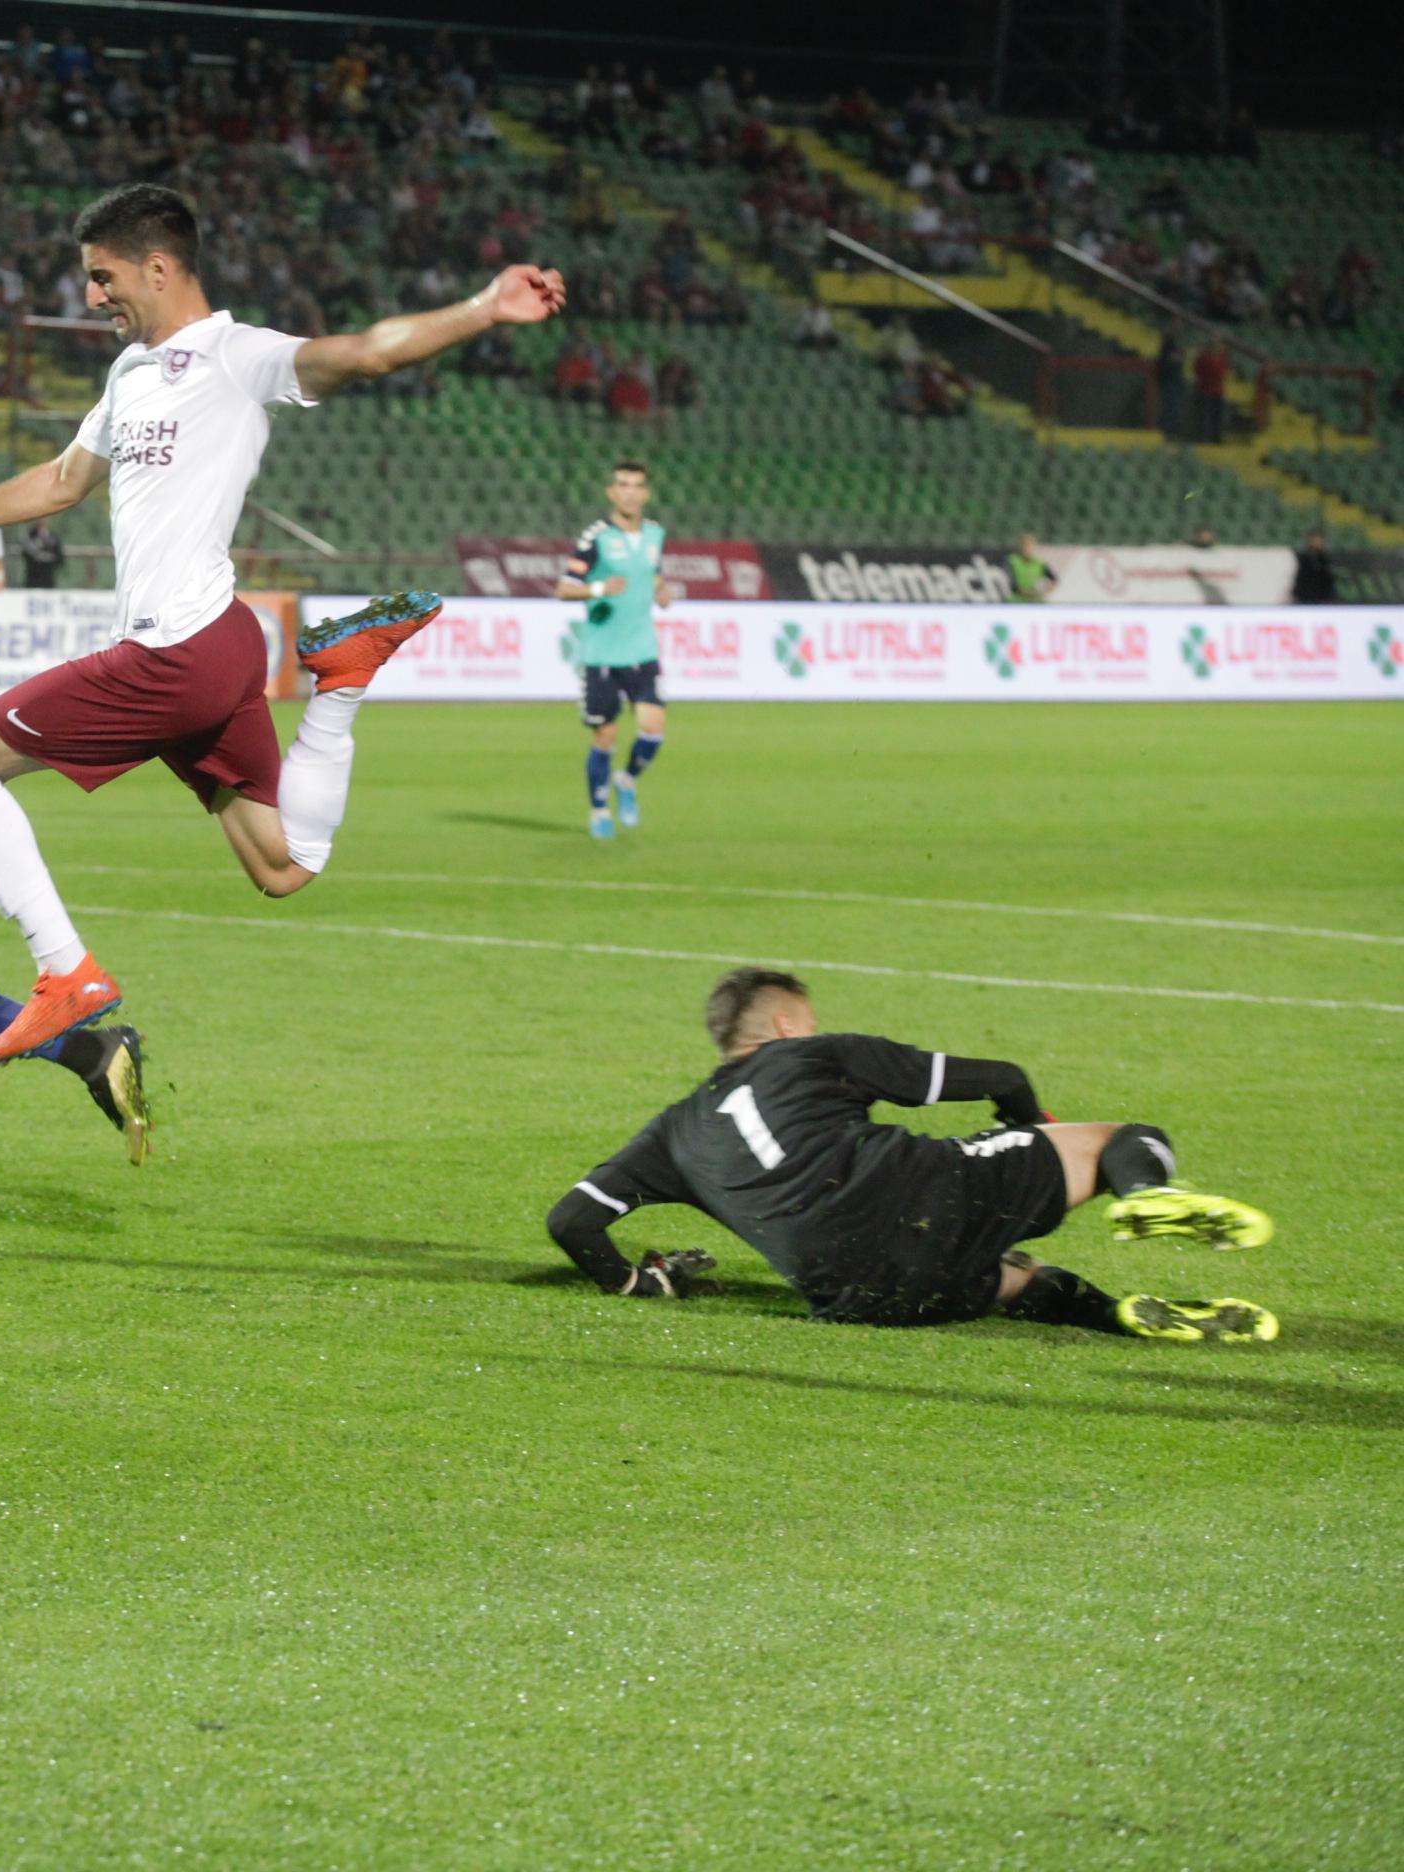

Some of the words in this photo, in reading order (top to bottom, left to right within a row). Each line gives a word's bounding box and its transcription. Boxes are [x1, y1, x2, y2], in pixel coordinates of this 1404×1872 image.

[798, 552, 1012, 601] telemach
[655, 621, 740, 659] TRIJA
[823, 621, 946, 660] LUTRIJA
[1030, 623, 1148, 662] LUTRIJA
[1226, 624, 1338, 662] LUTRIJA
[715, 1084, 787, 1170] 1
